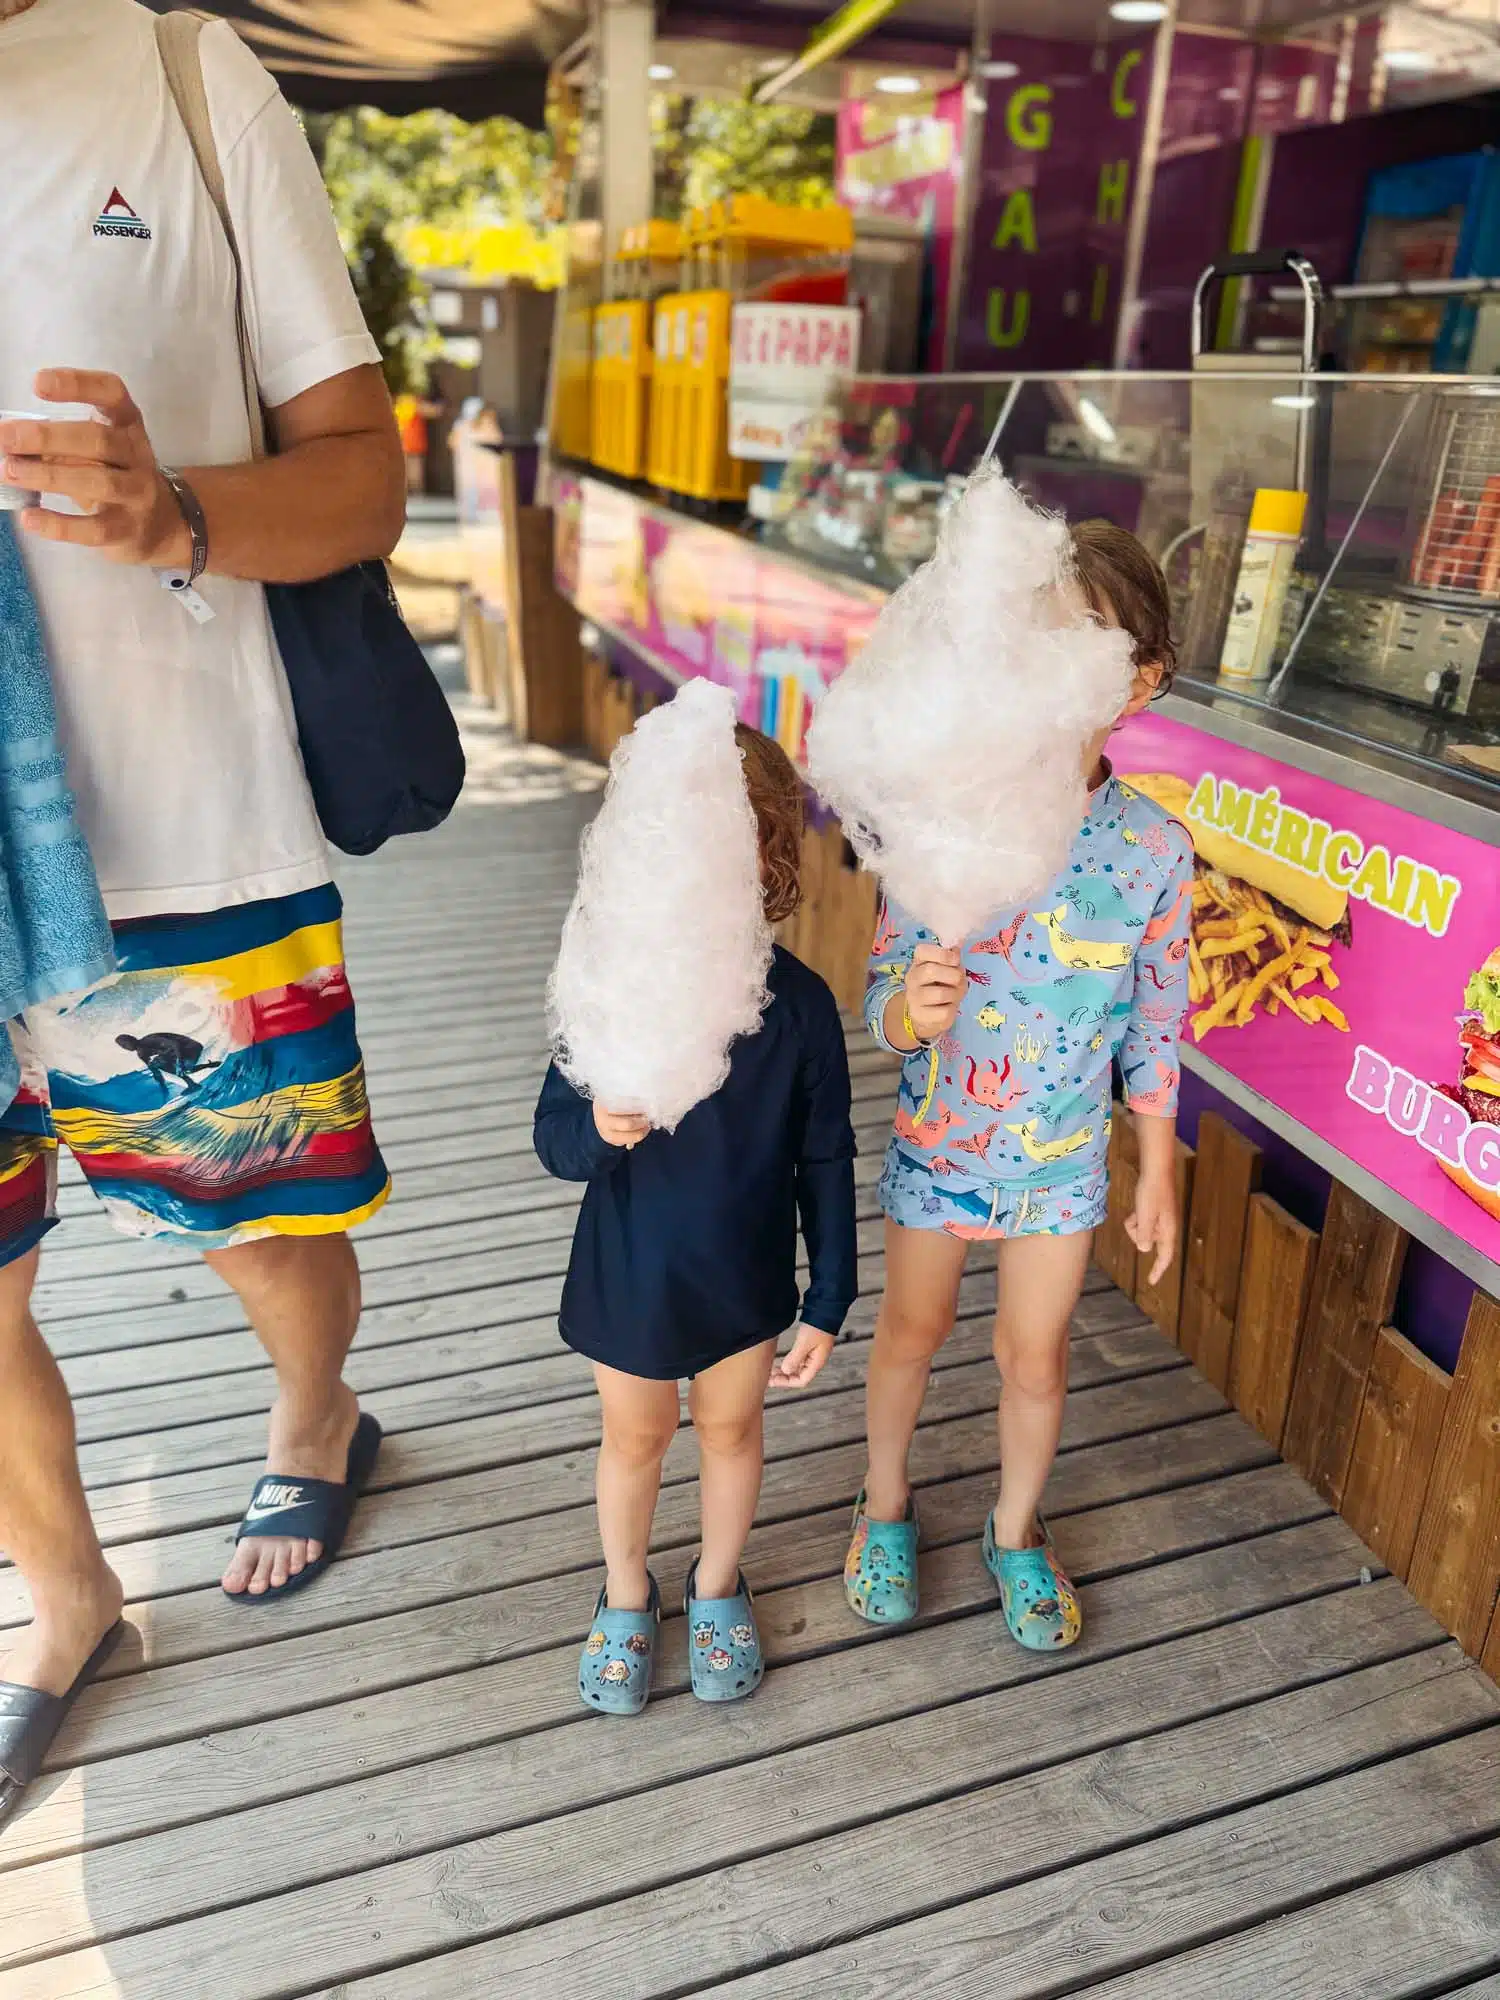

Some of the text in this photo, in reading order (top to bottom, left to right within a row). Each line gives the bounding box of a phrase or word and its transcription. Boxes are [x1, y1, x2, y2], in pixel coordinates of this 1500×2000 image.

[92, 224, 152, 240] PASSENGER
[1186, 772, 1461, 937] AMÉRICAIN
[1345, 1044, 1500, 1191] BURG
[255, 1484, 304, 1507] NIKE
